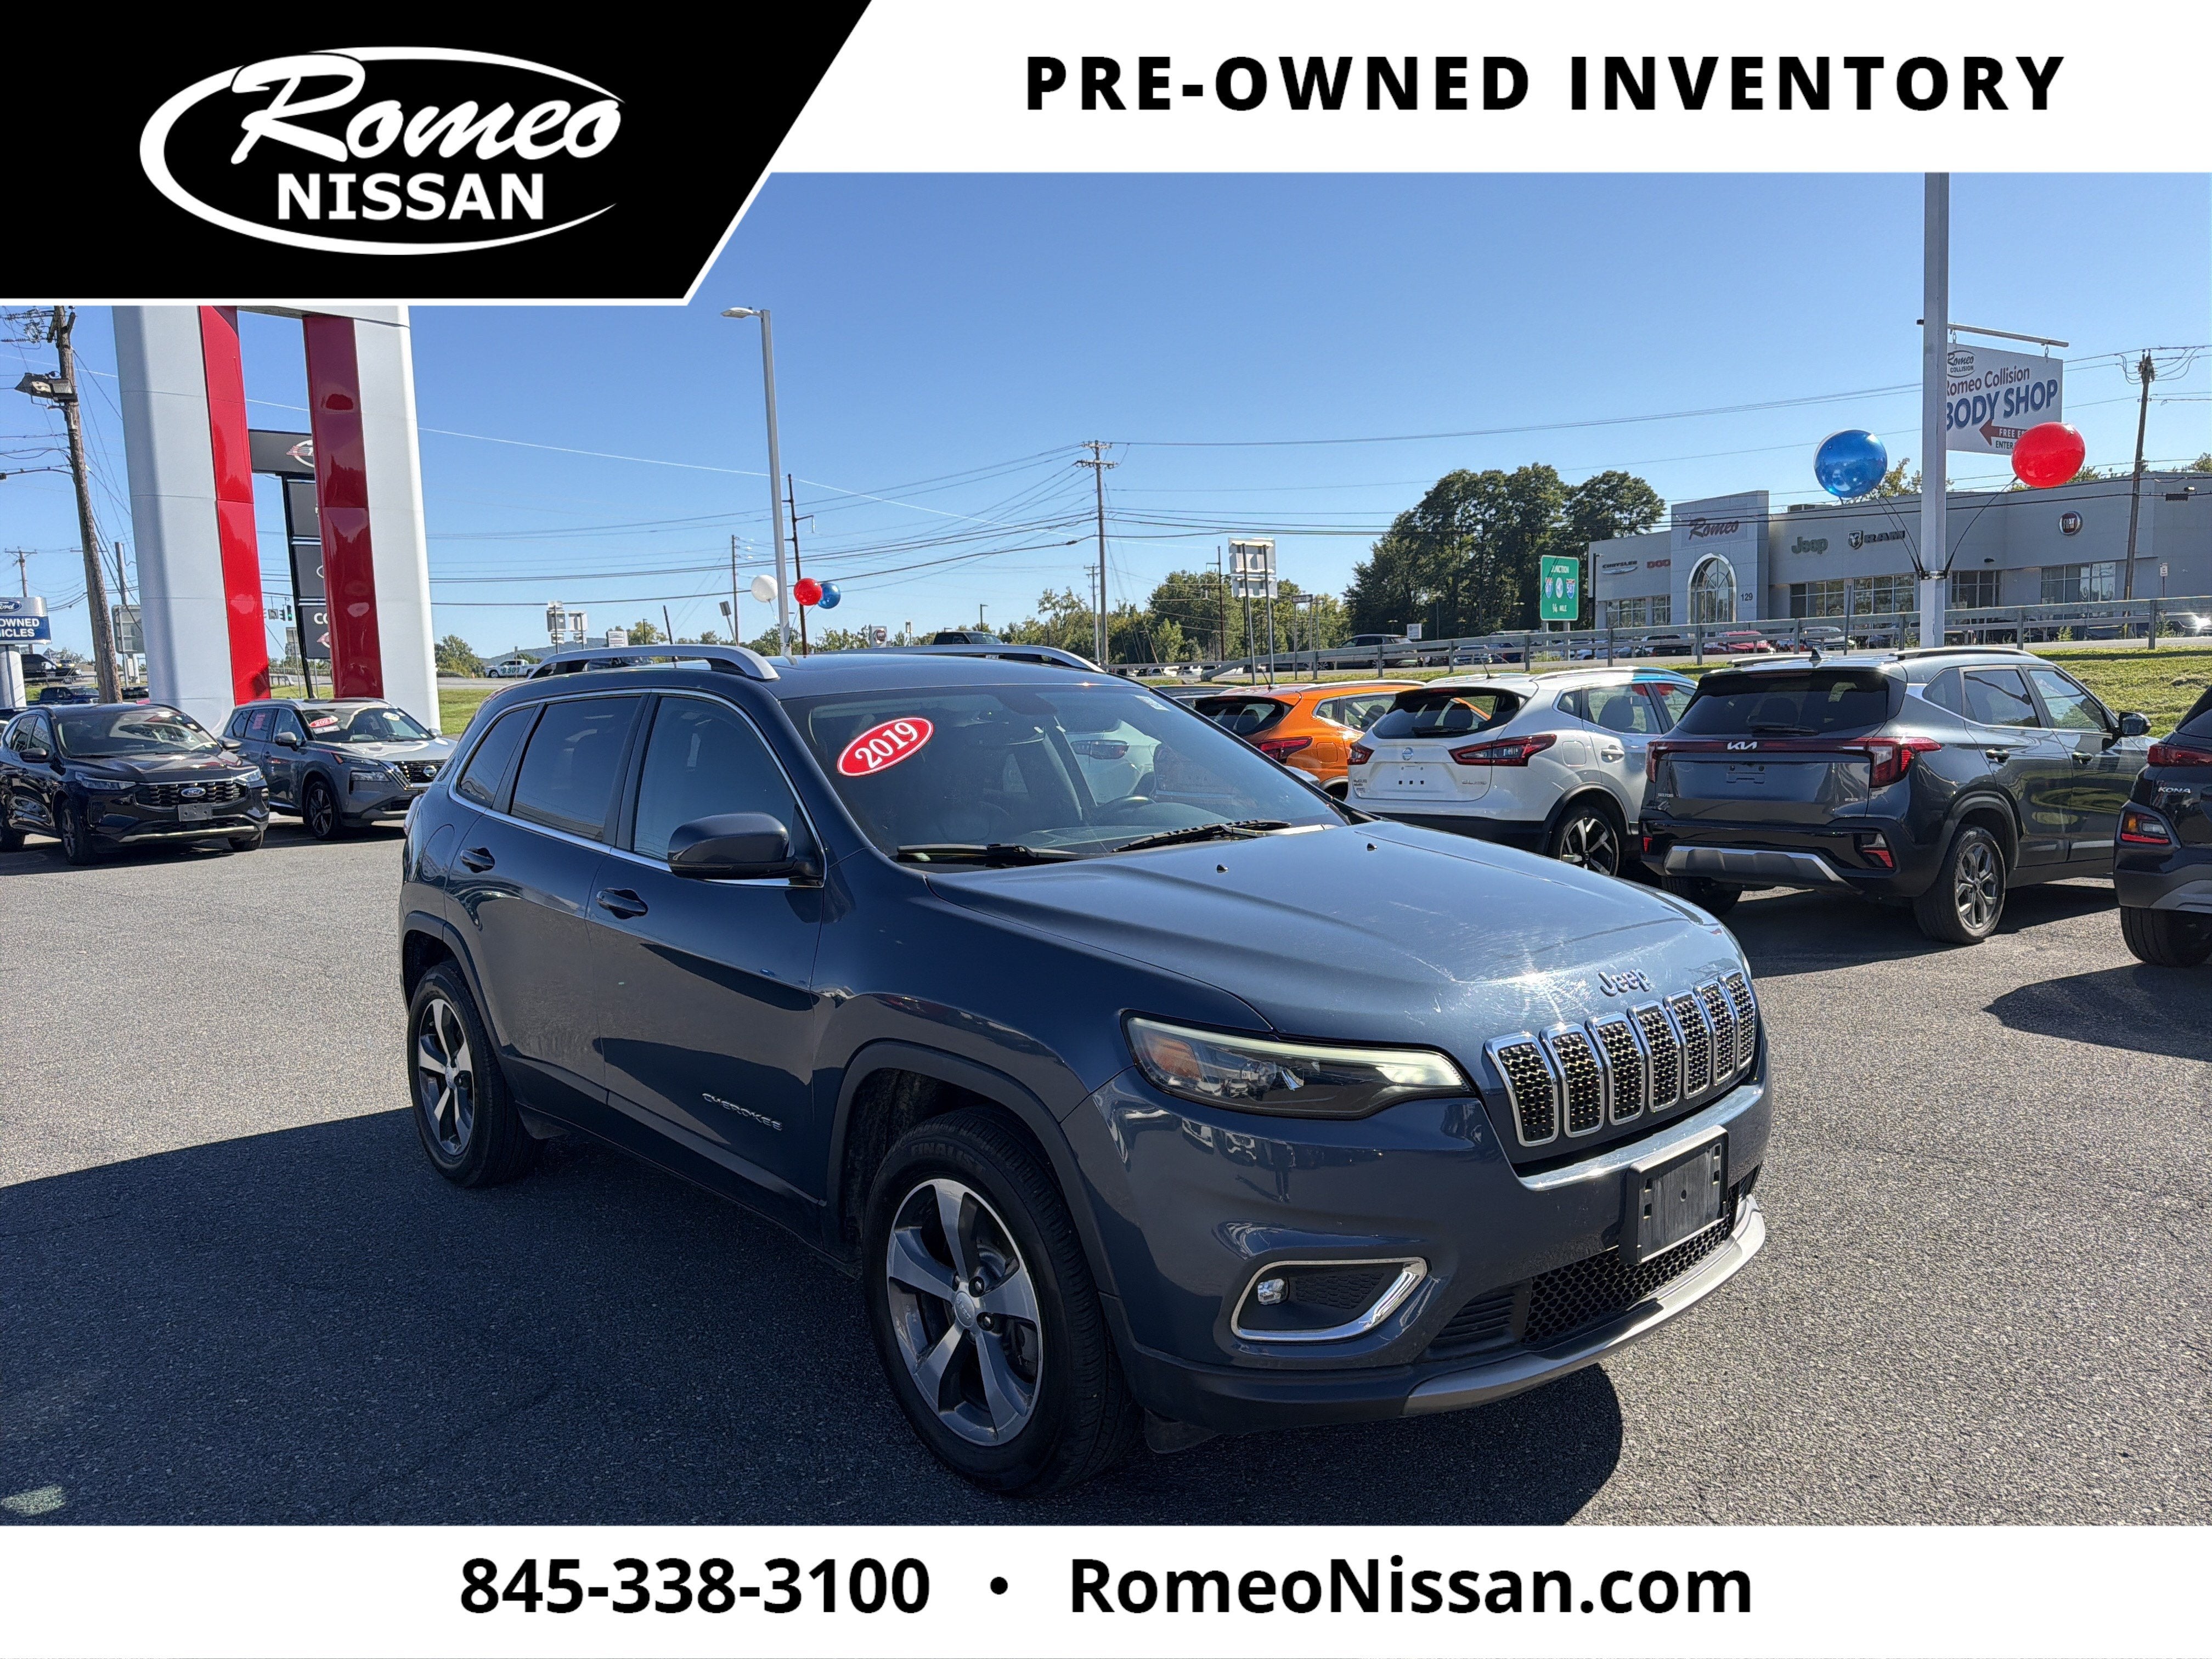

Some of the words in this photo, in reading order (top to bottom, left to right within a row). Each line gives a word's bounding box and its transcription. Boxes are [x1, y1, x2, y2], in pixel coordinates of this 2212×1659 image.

[1948, 352, 1974, 366] Romeo
[1950, 365, 1974, 373] COLLISION
[1984, 365, 2030, 388] Collision
[2003, 379, 2058, 419] SHOP
[1999, 428, 2015, 438] FREE
[1995, 440, 2013, 449] ENTER
[1689, 517, 1739, 540] Romeo
[1864, 531, 1905, 543] RAM
[1791, 536, 1828, 555] Jeep
[1740, 592, 1753, 601] 129
[1, 628, 35, 637] ICLES
[855, 722, 918, 769] 2019
[1598, 968, 1651, 997] Jeep
[702, 1093, 783, 1131] CHEROKEE
